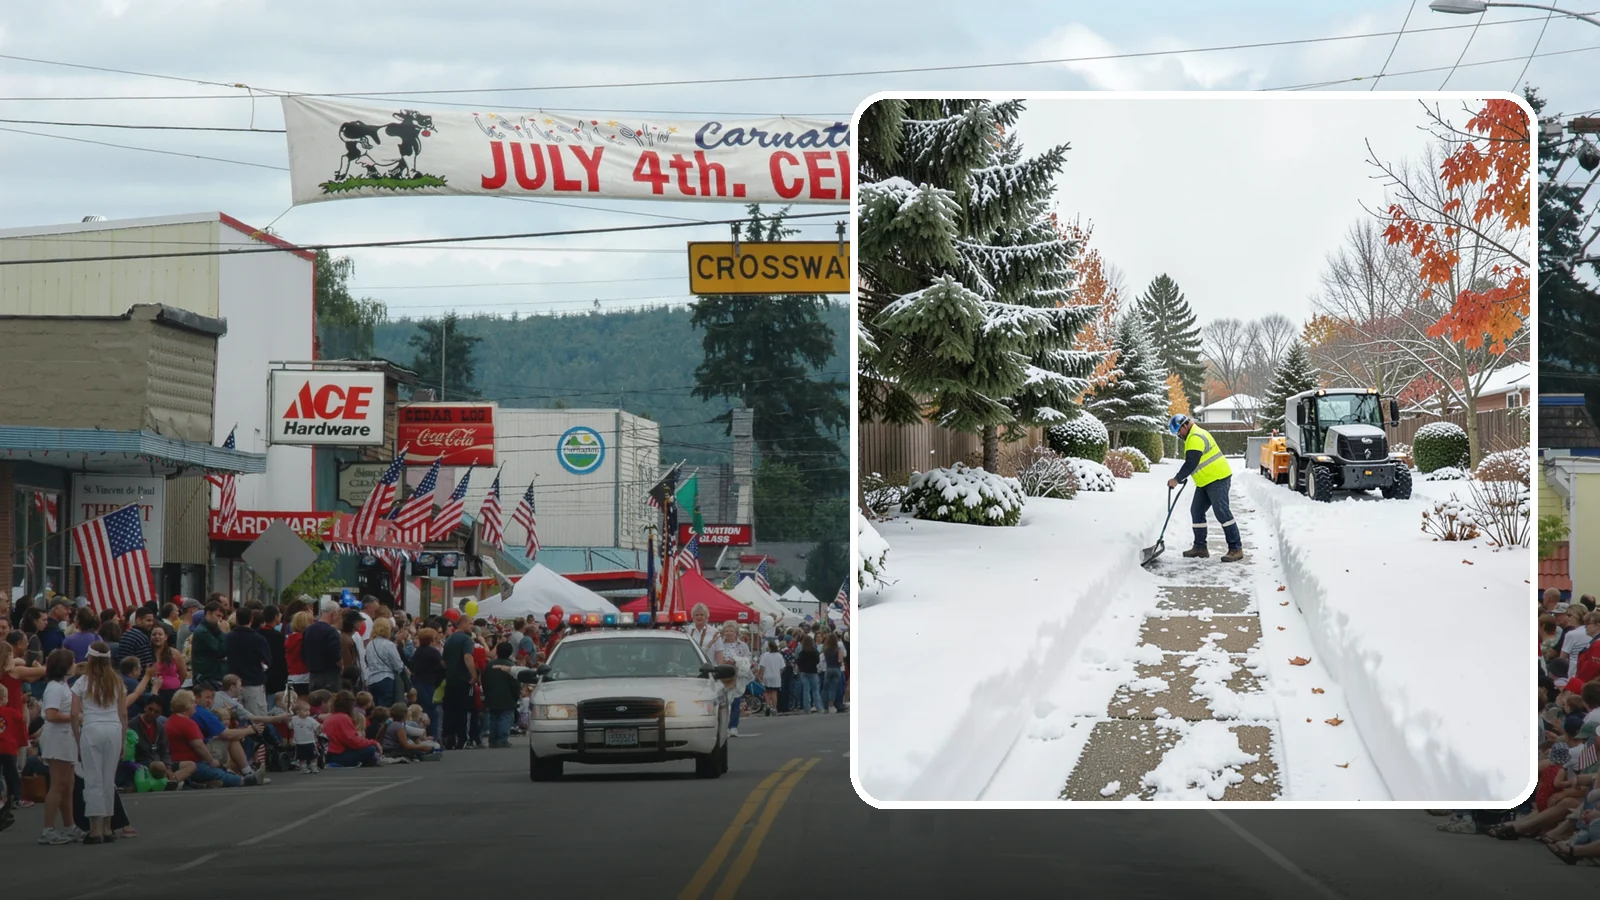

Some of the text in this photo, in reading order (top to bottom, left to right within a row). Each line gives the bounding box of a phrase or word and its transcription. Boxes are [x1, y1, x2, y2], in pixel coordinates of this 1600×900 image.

[481, 141, 605, 192] JULY
[632, 149, 746, 198] 4th.
[696, 254, 850, 280] CROSSWA
[282, 380, 373, 420] ACE
[405, 409, 452, 422] CEDAR
[283, 421, 371, 437] Hardware
[416, 428, 476, 447] Coca-Cola
[354, 466, 384, 480] Simpl
[83, 485, 155, 495] St. Vincent de Paul
[688, 526, 741, 535] CRNATION
[699, 535, 730, 543] GLASS
